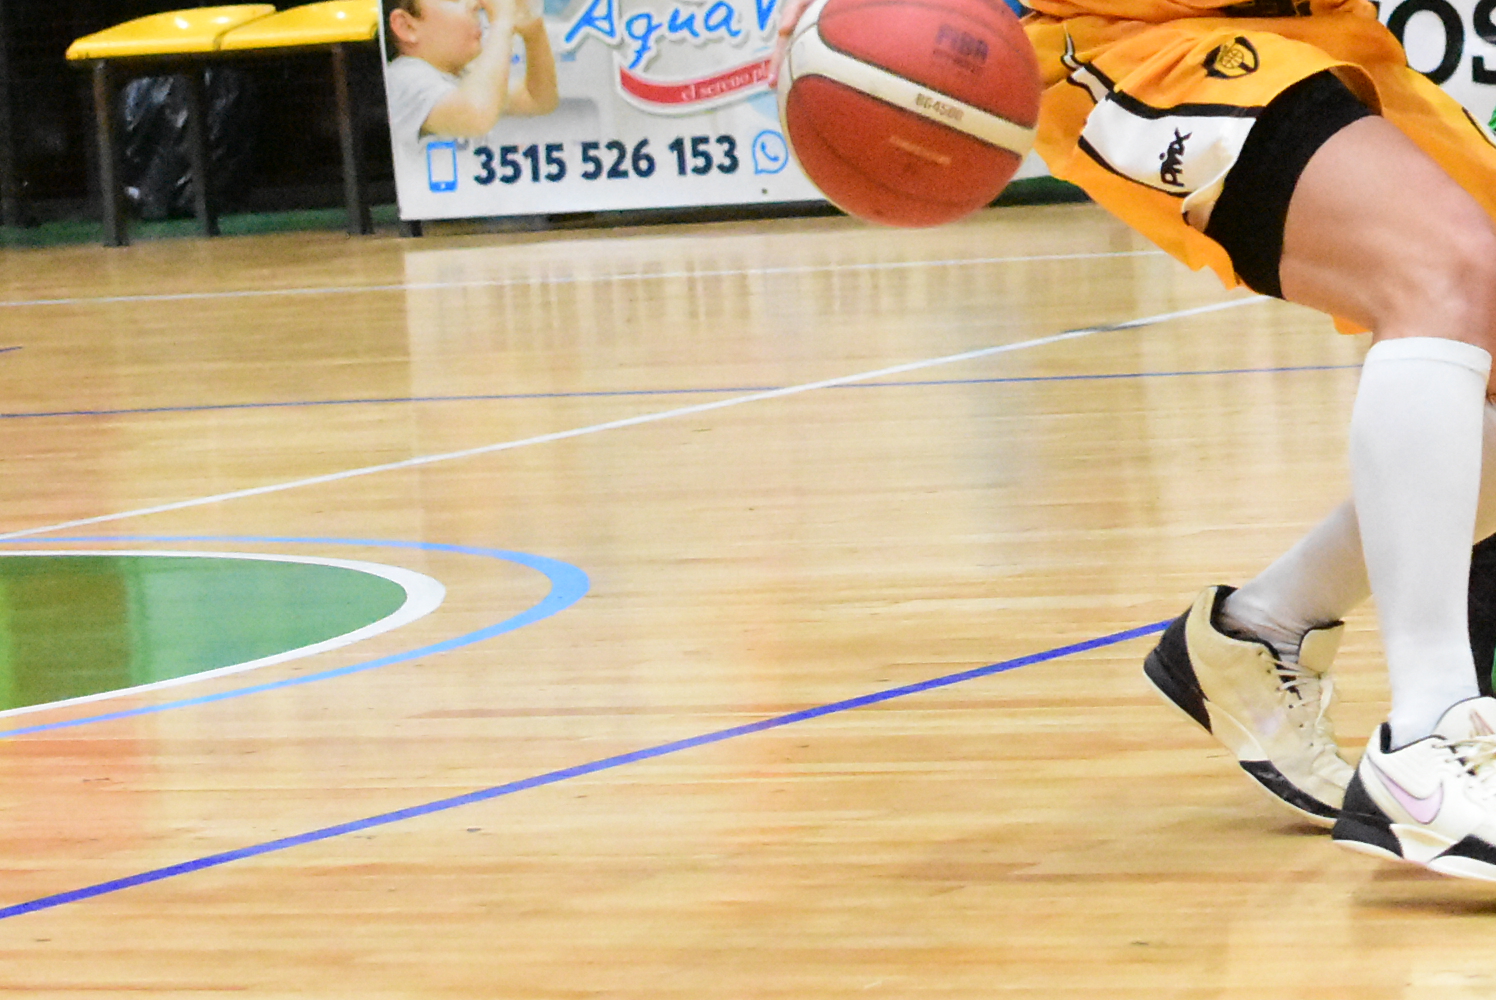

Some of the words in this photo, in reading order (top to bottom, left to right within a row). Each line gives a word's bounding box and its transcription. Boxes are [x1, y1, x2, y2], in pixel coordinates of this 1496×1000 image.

[472, 143, 567, 185] 3515
[580, 140, 655, 179] 526
[668, 134, 739, 176] 153
